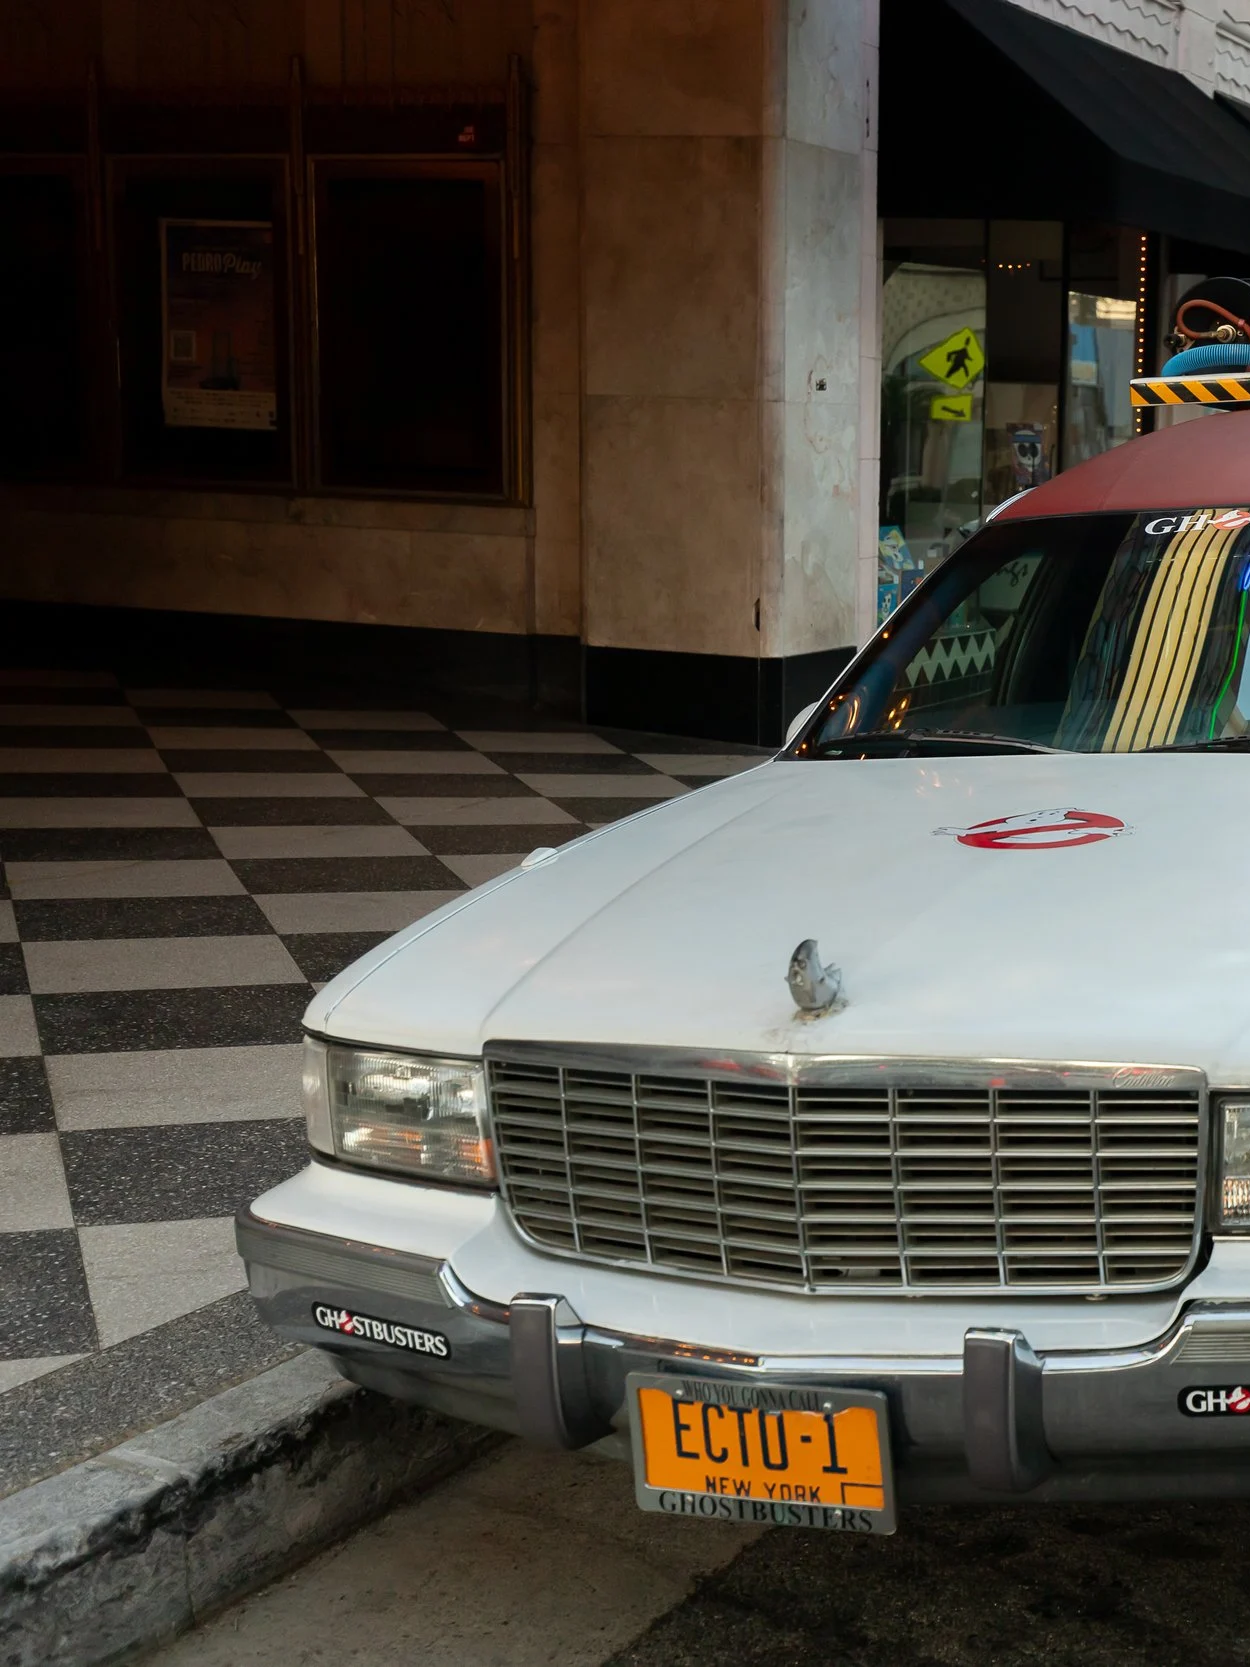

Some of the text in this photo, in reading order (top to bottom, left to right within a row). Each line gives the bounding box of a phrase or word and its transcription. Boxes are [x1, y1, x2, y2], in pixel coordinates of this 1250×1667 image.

[682, 1380, 820, 1411] WHO YOU GONNA CALL
[672, 1400, 848, 1474] ECTO-1
[705, 1475, 821, 1503] NEW YORK
[658, 1490, 873, 1533] GHOSTBUSTERS
